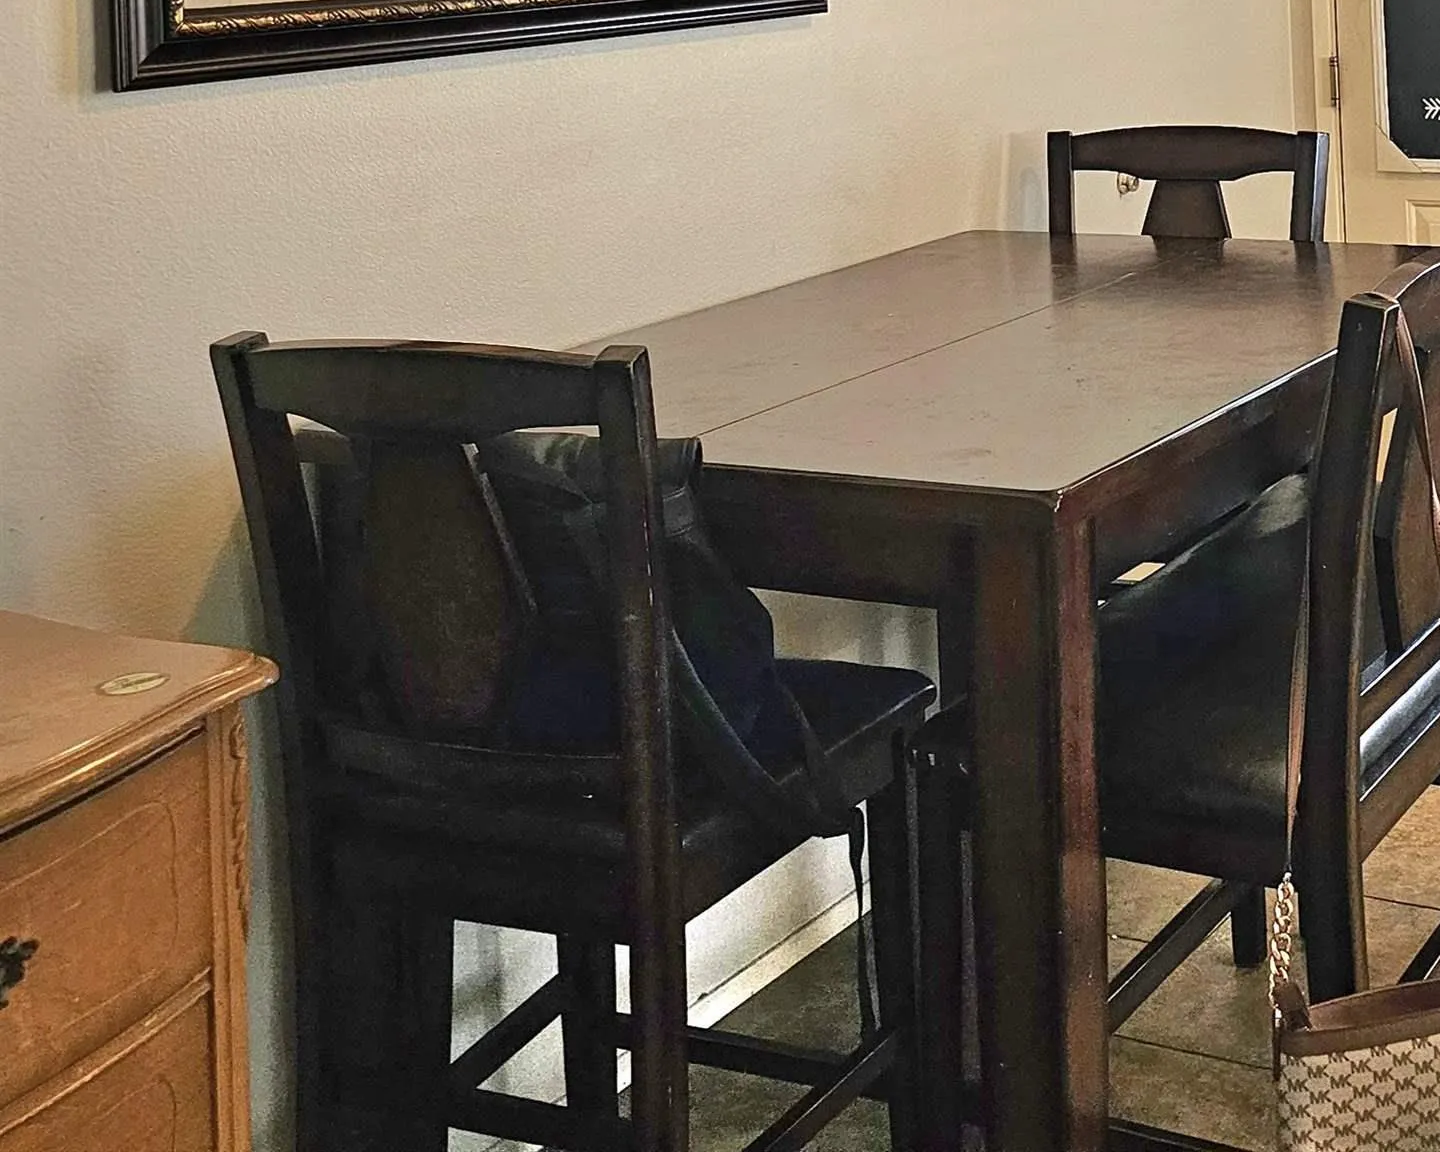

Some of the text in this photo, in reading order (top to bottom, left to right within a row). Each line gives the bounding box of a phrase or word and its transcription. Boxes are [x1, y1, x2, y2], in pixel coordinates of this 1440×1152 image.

[1350, 1059, 1371, 1074] MK
[1394, 1052, 1415, 1067] MK
[1308, 1064, 1329, 1079] MK
[1414, 1060, 1435, 1075] MK
[1330, 1074, 1351, 1089] MK
[1374, 1068, 1395, 1083] MK
[1288, 1078, 1310, 1093] MK
[1395, 1076, 1416, 1091] MK
[1310, 1089, 1331, 1104] MK
[1352, 1084, 1373, 1099] MK
[1417, 1085, 1438, 1100] MK
[1333, 1099, 1354, 1114] MK
[1377, 1093, 1398, 1108] MK
[1290, 1104, 1311, 1119] MK
[1355, 1108, 1376, 1123] MK
[1399, 1101, 1420, 1116] MK
[1312, 1115, 1333, 1130] MK
[1378, 1116, 1399, 1131] MK
[1419, 1110, 1440, 1125] MK
[1293, 1130, 1314, 1145] MK
[1336, 1123, 1357, 1138] MK
[1357, 1131, 1378, 1146] MK
